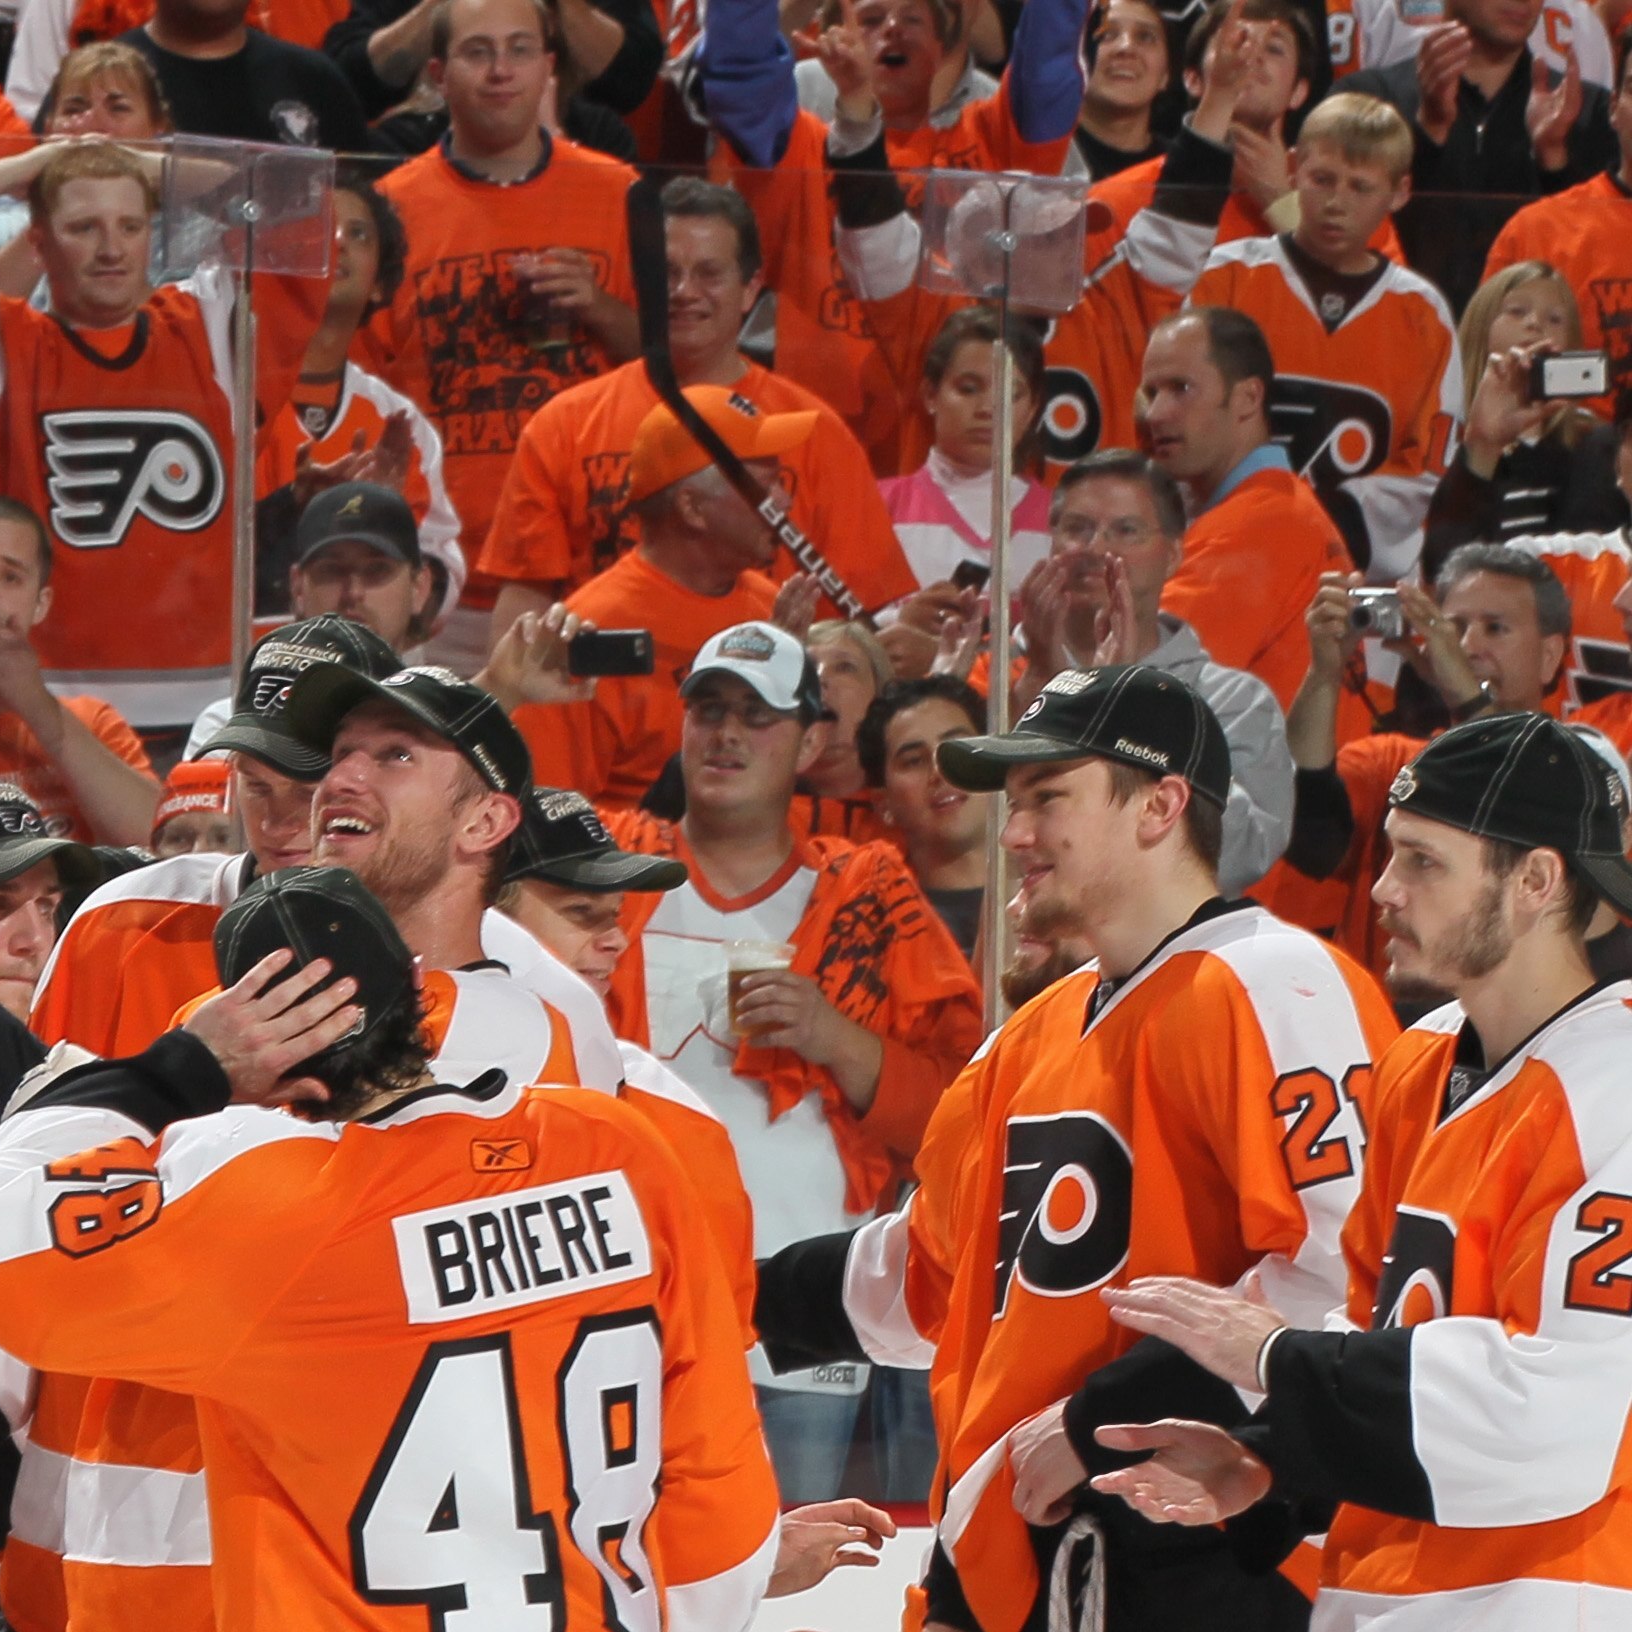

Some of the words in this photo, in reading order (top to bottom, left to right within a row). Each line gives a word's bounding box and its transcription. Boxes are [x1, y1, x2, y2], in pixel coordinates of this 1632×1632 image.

[1114, 738, 1169, 768] Reebok
[425, 1186, 632, 1307] BRIERE
[1563, 1190, 1632, 1318] 2
